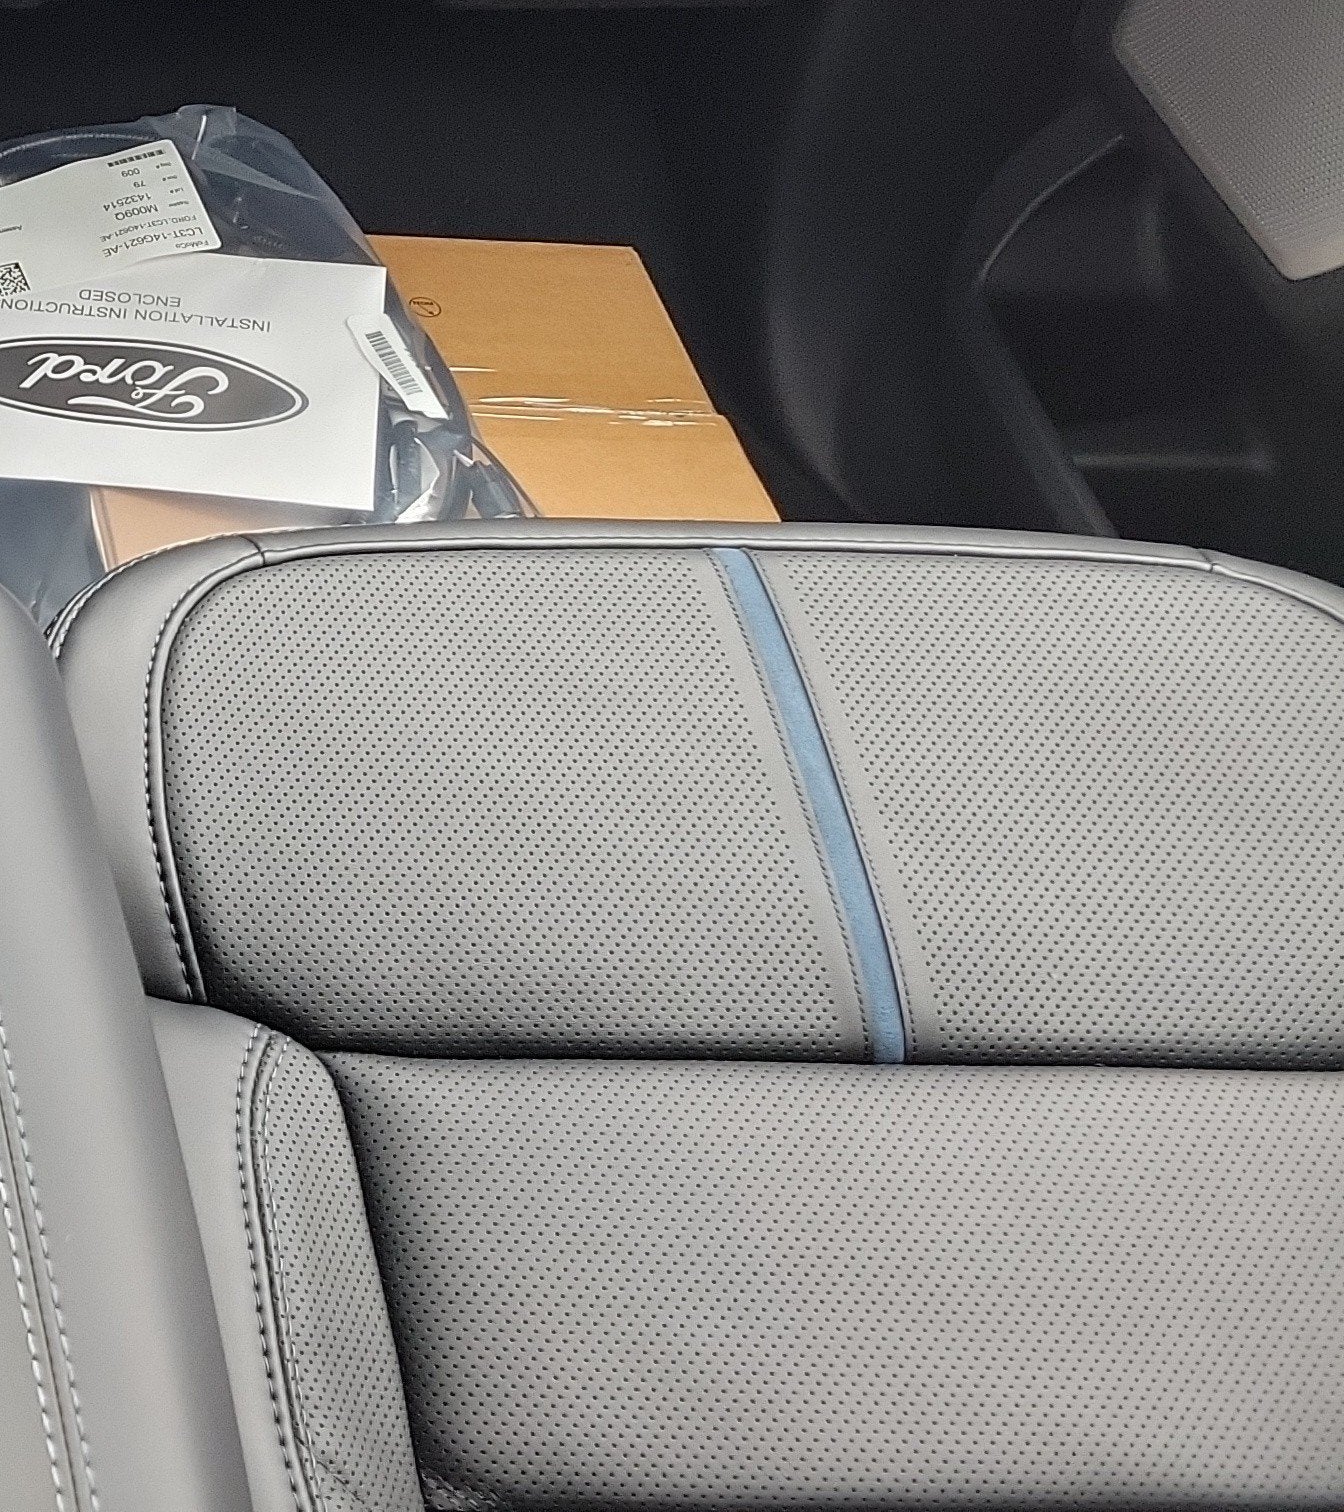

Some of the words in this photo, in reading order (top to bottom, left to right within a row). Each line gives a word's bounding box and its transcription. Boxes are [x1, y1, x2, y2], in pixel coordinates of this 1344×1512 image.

[121, 168, 140, 178] 009
[133, 180, 146, 188] 79
[103, 193, 152, 212] 1432514
[115, 204, 159, 221] M009Q
[102, 227, 204, 258] LC3T-14G621-AE
[79, 289, 181, 308] ENCLOSED
[134, 308, 271, 333] INSTALLATION
[18, 352, 229, 418] Ford
